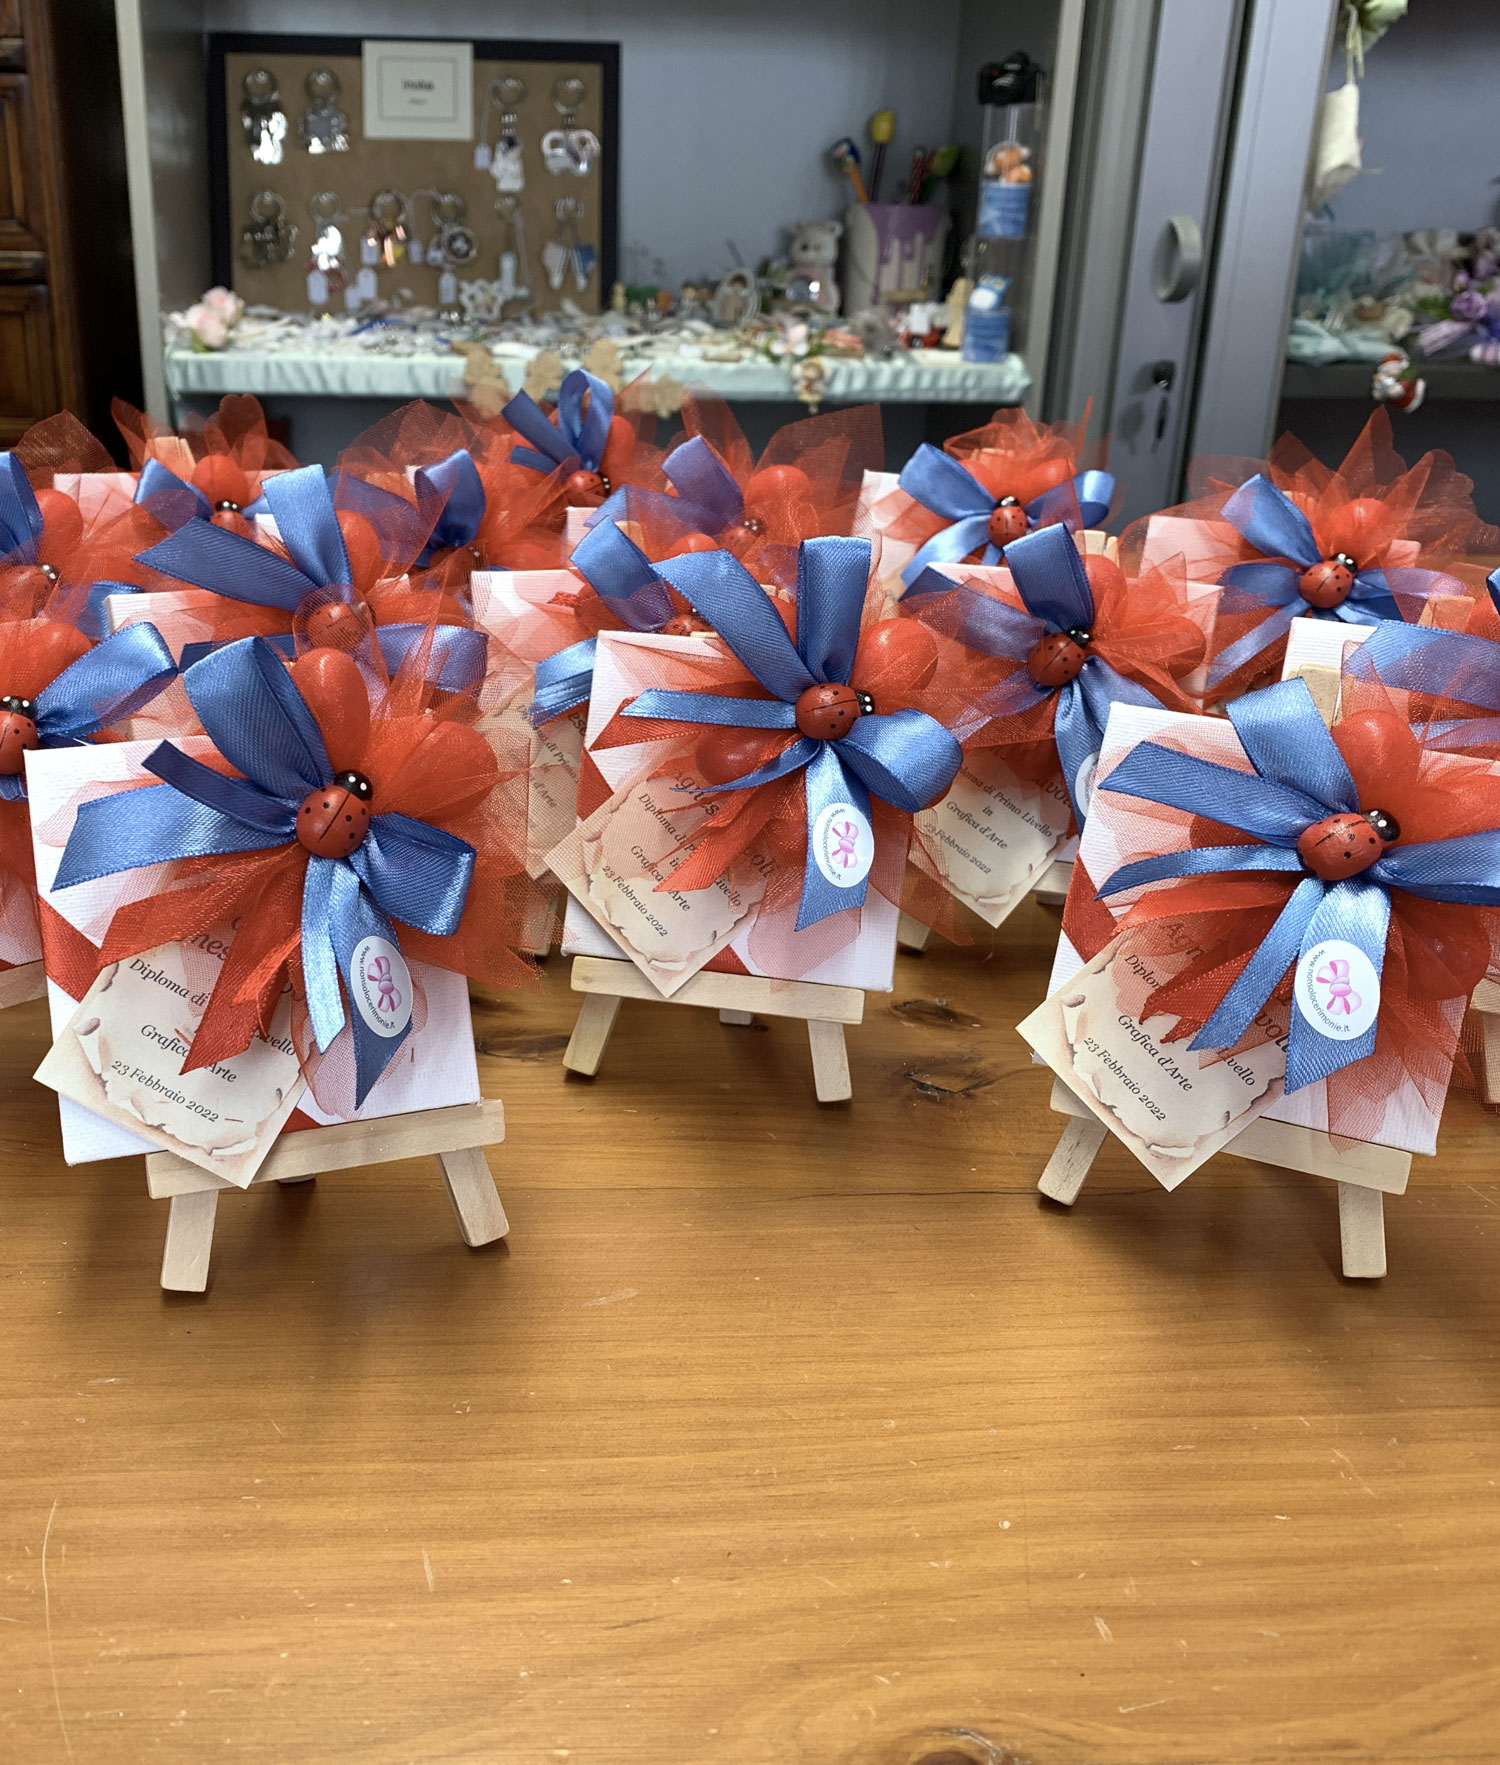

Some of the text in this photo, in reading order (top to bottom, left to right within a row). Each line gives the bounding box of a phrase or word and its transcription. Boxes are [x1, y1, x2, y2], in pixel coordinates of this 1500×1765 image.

[638, 793, 675, 835] Diploma
[946, 801, 1008, 850] Grafica d'Arte
[982, 804, 994, 817] in
[993, 791, 1021, 816] Primo
[1021, 811, 1053, 838] Livello
[631, 845, 691, 912] Grafca Arte
[935, 828, 970, 859] Febbraio
[969, 856, 992, 875] 2022
[602, 865, 669, 937] 23 Febbraio 2022
[129, 958, 297, 1057] Diploma di vello
[1125, 955, 1256, 1086] Diplo vello
[1306, 949, 1351, 1032] www.nonsolocerimonie.it
[204, 1061, 238, 1083] Arte
[1084, 1037, 1167, 1121] 23 Febbraio 2022
[1117, 1014, 1194, 1092] Grafica d'Arte
[111, 1060, 219, 1123] 23 Febbraio 2022
